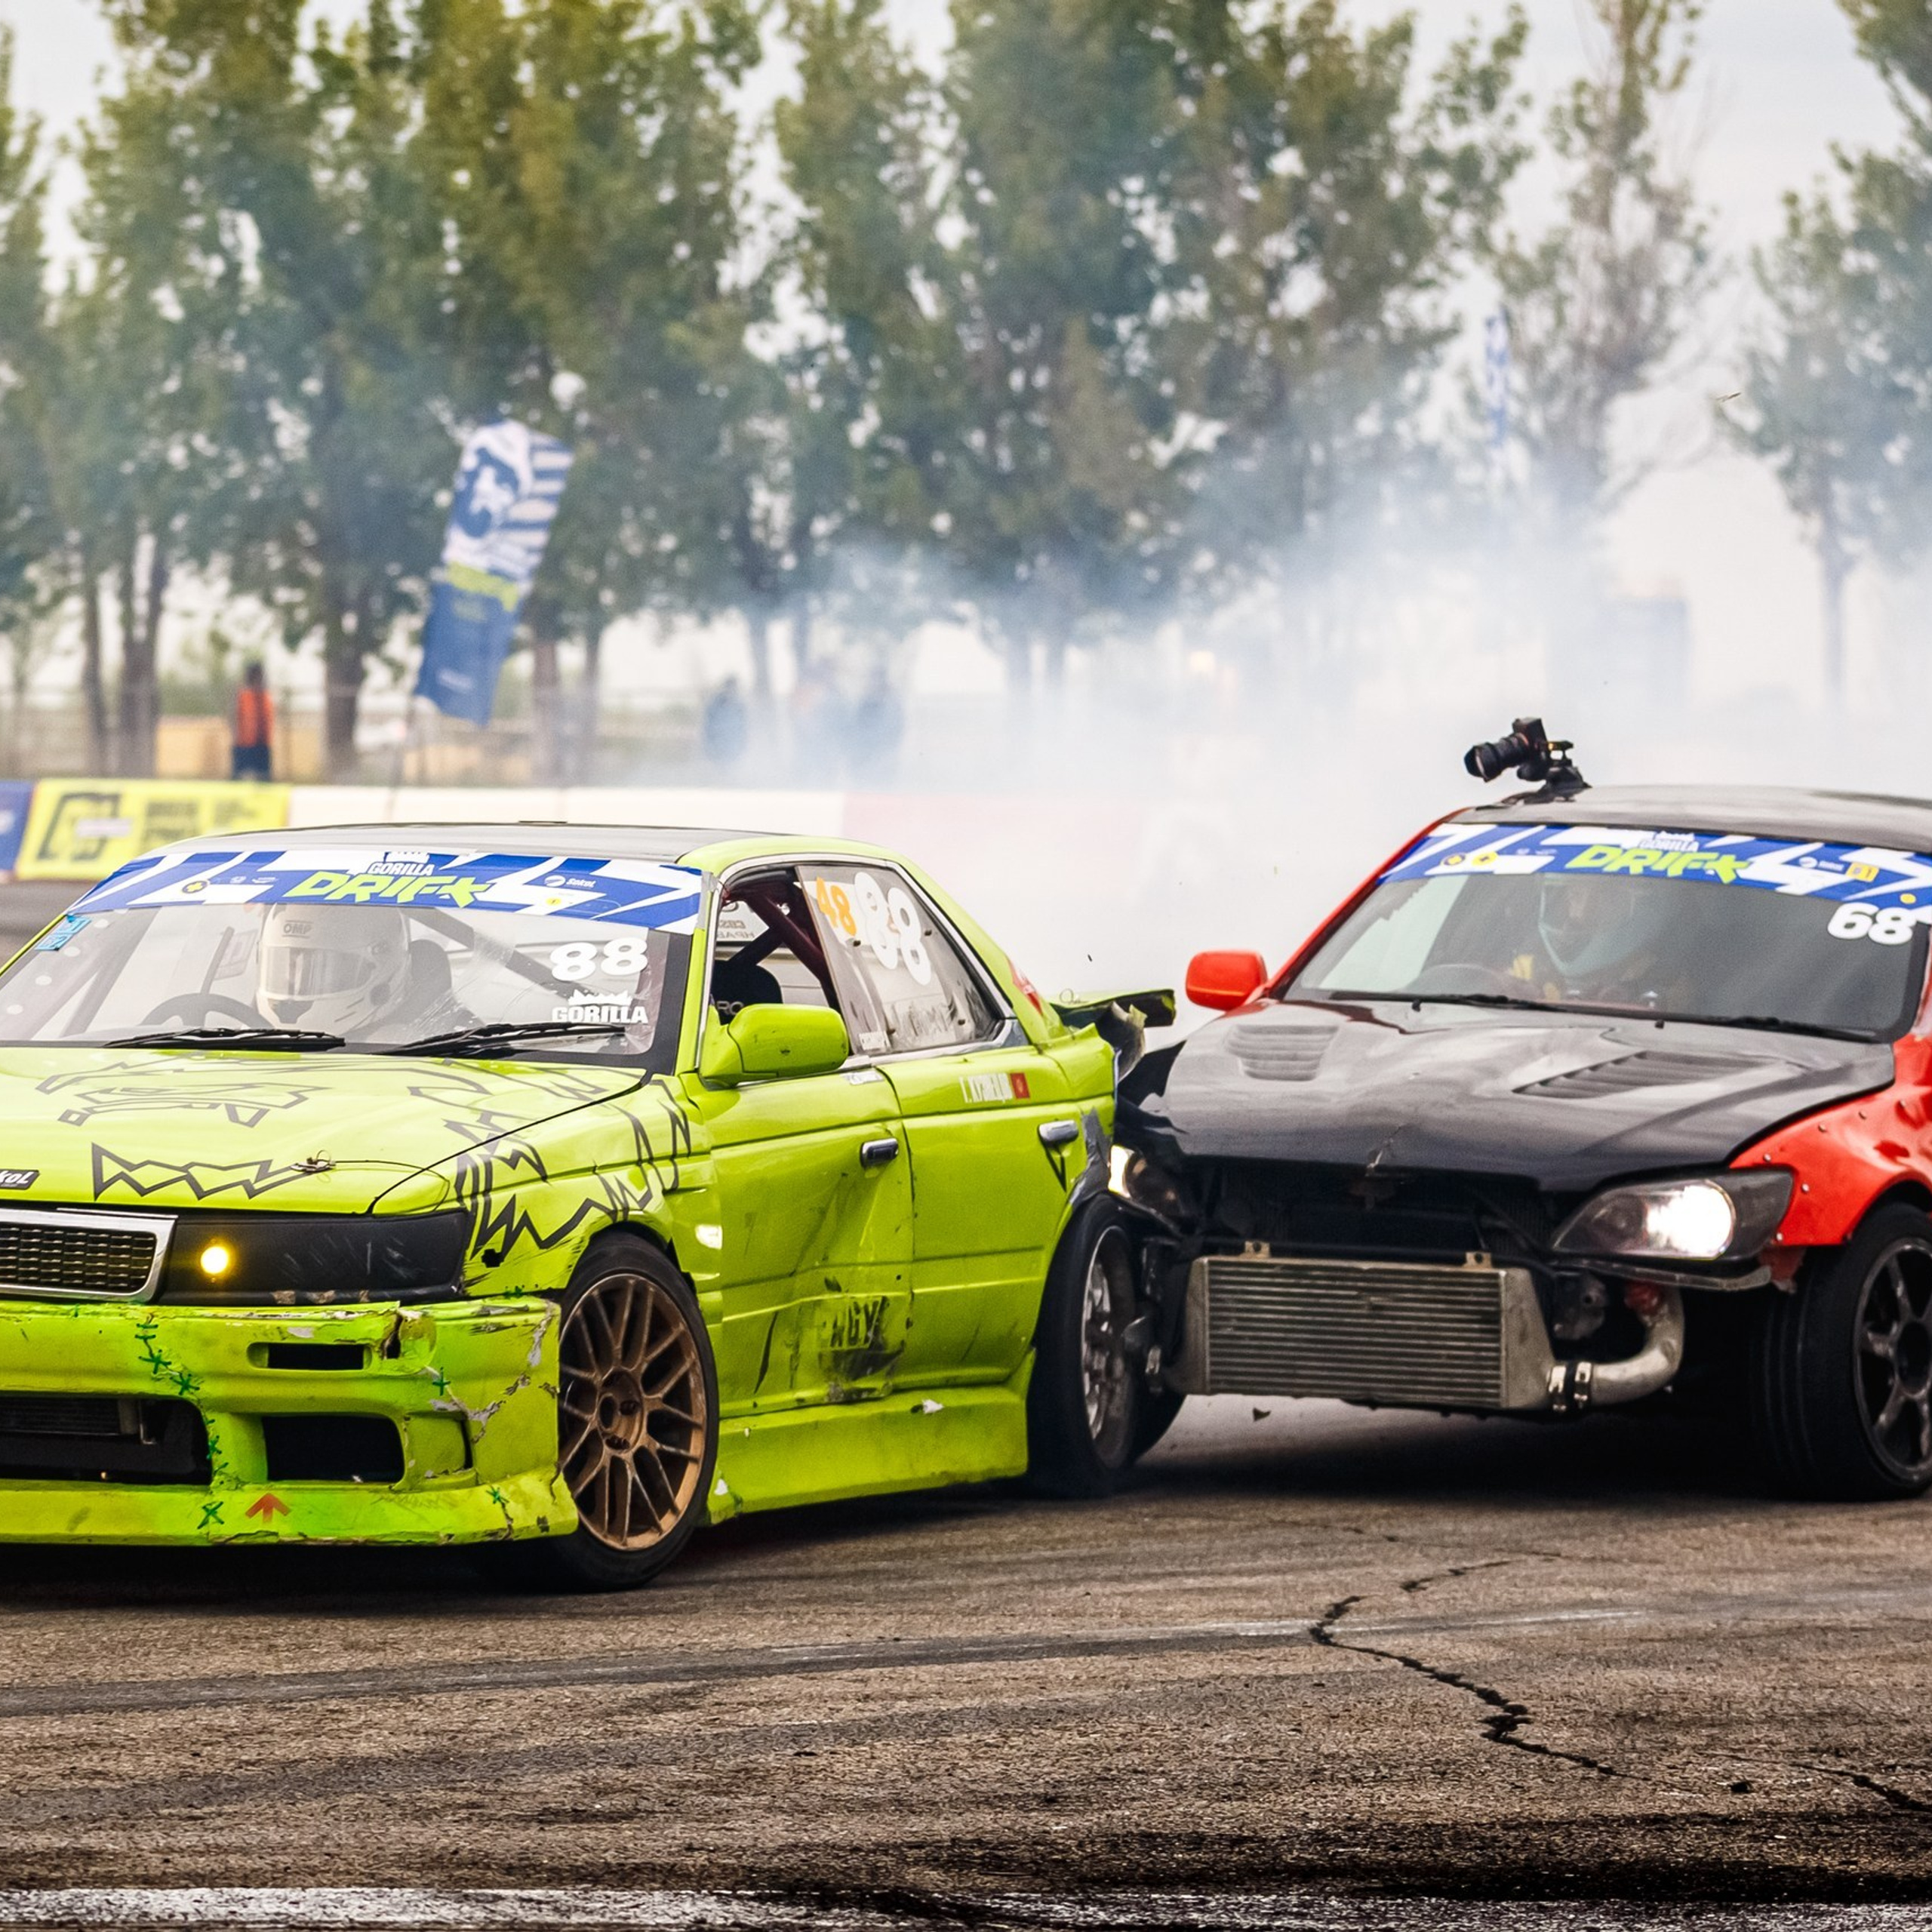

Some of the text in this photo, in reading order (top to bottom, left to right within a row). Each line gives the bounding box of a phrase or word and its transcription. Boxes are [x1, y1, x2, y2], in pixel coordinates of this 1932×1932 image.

[367, 863, 435, 875] GORILLA
[1565, 844, 1749, 884] DRIFT
[281, 871, 492, 908] DRIFT
[816, 877, 857, 937] 48
[283, 923, 312, 934] OMP
[1827, 903, 1917, 945] 68
[549, 937, 648, 981] 88
[552, 1006, 648, 1023] GORILLA
